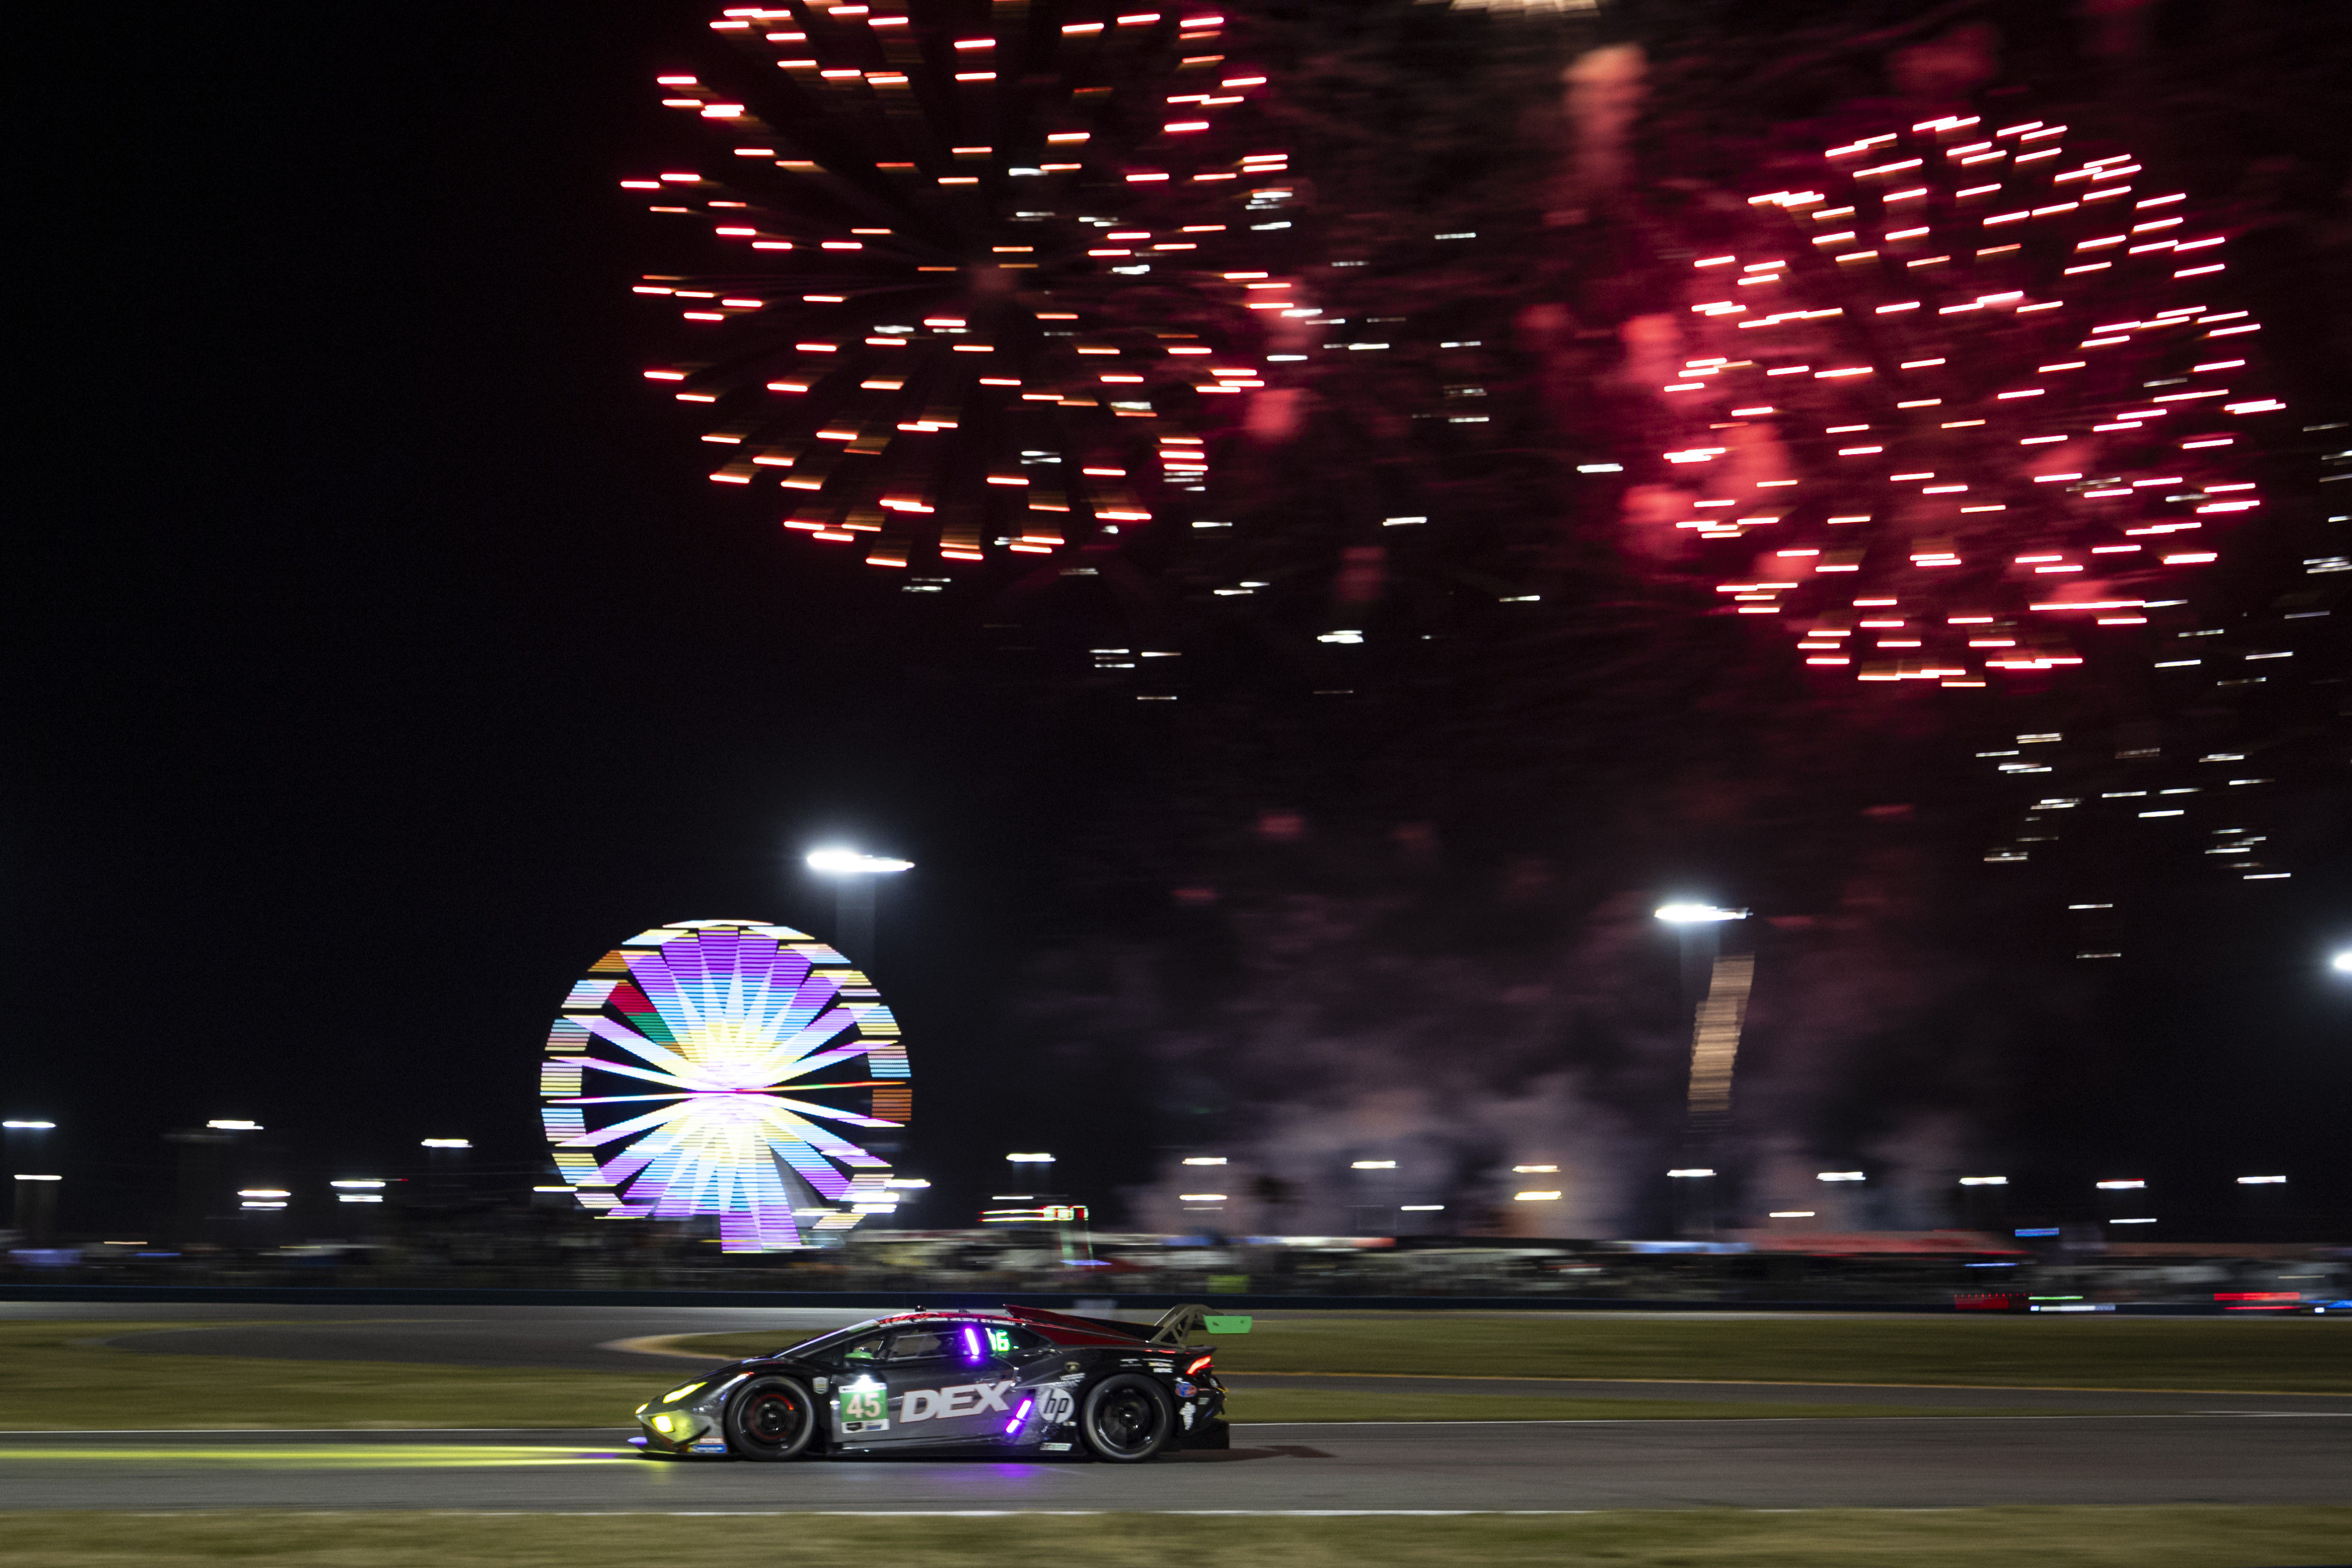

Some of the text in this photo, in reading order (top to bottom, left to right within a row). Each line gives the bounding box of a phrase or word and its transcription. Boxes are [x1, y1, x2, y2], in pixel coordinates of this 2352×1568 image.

[846, 1392, 881, 1418] 45
[900, 1380, 1014, 1423] DEX
[1044, 1388, 1069, 1422] hp
